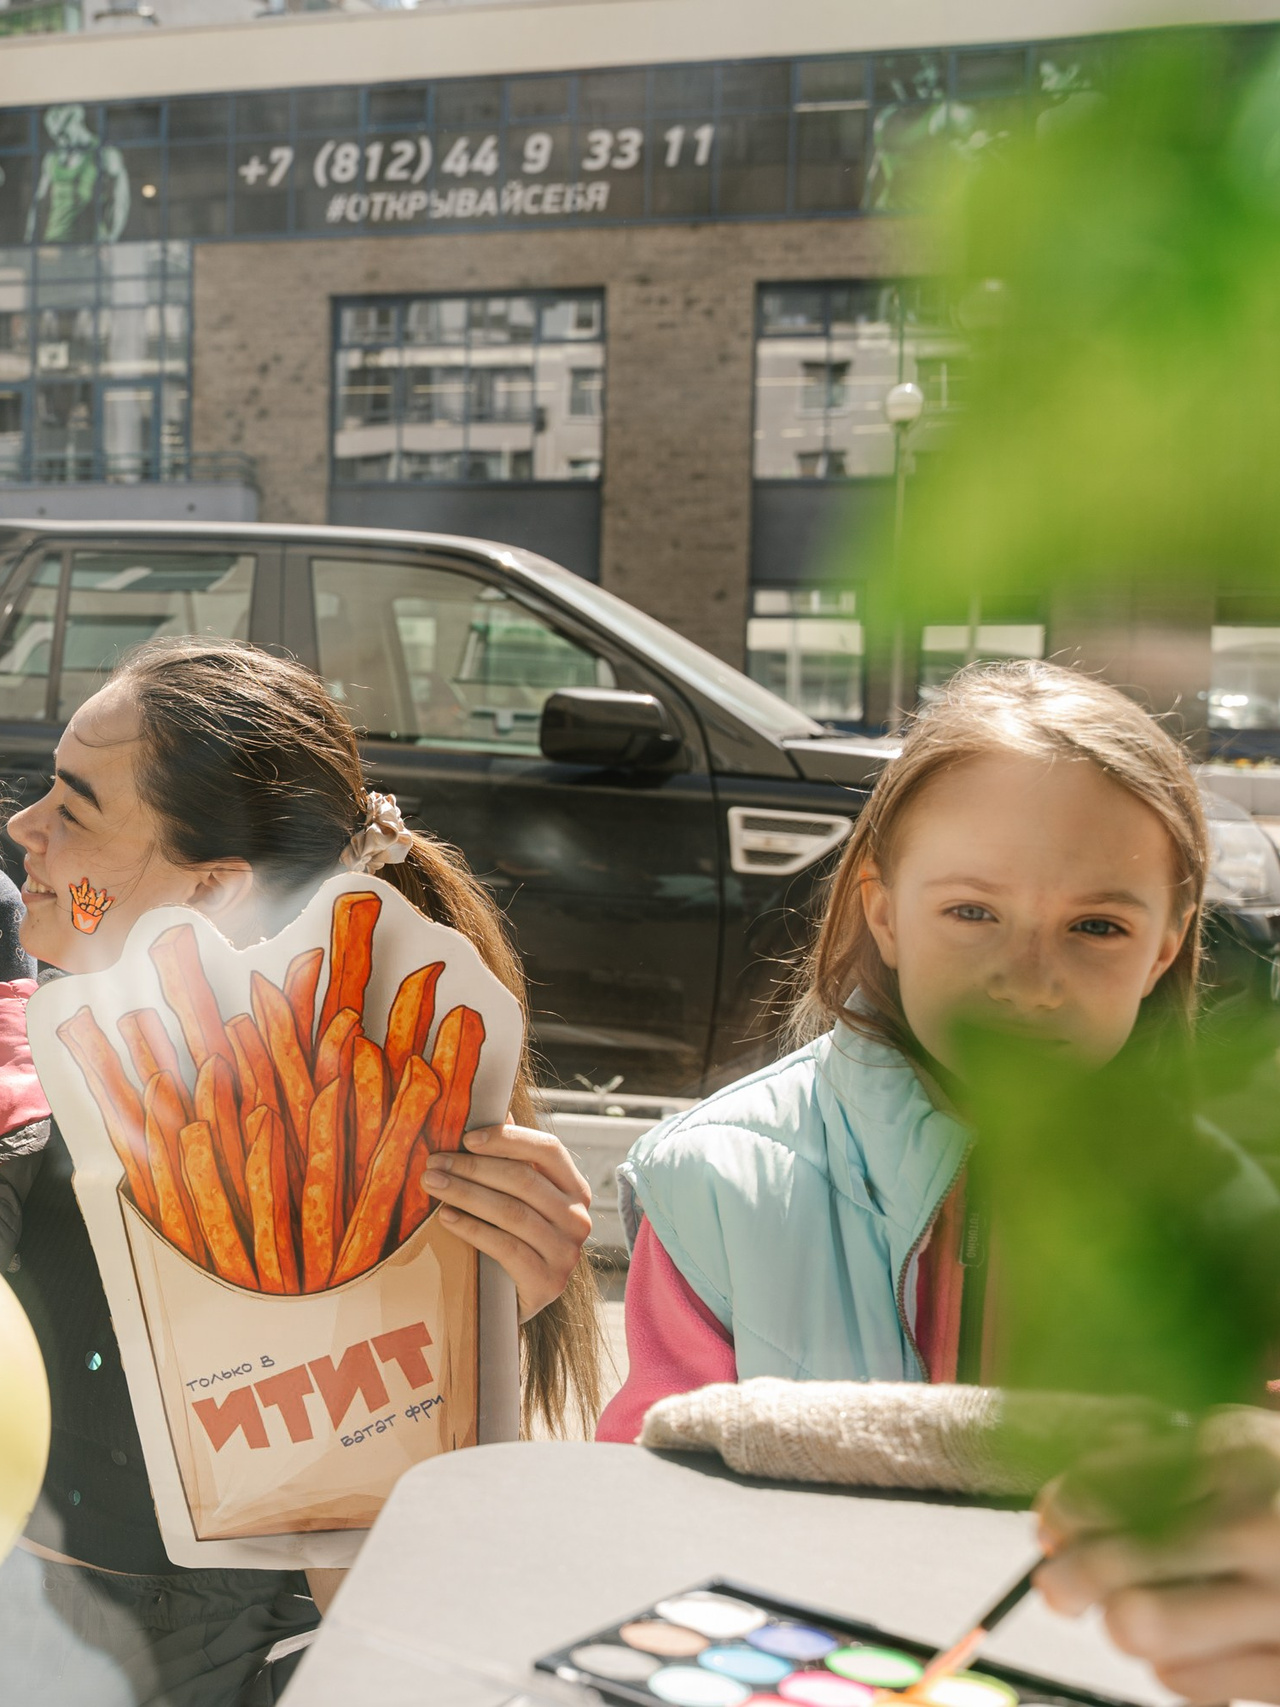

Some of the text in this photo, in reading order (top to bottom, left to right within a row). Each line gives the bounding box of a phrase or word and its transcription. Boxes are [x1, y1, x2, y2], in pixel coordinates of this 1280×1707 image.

[239, 123, 716, 189] +7 (812) 44 9 33 11
[325, 179, 610, 224] #ОТКРЫВАЙСЕБЯ
[191, 1321, 434, 1453] ИТИТ
[404, 1394, 445, 1423] фри
